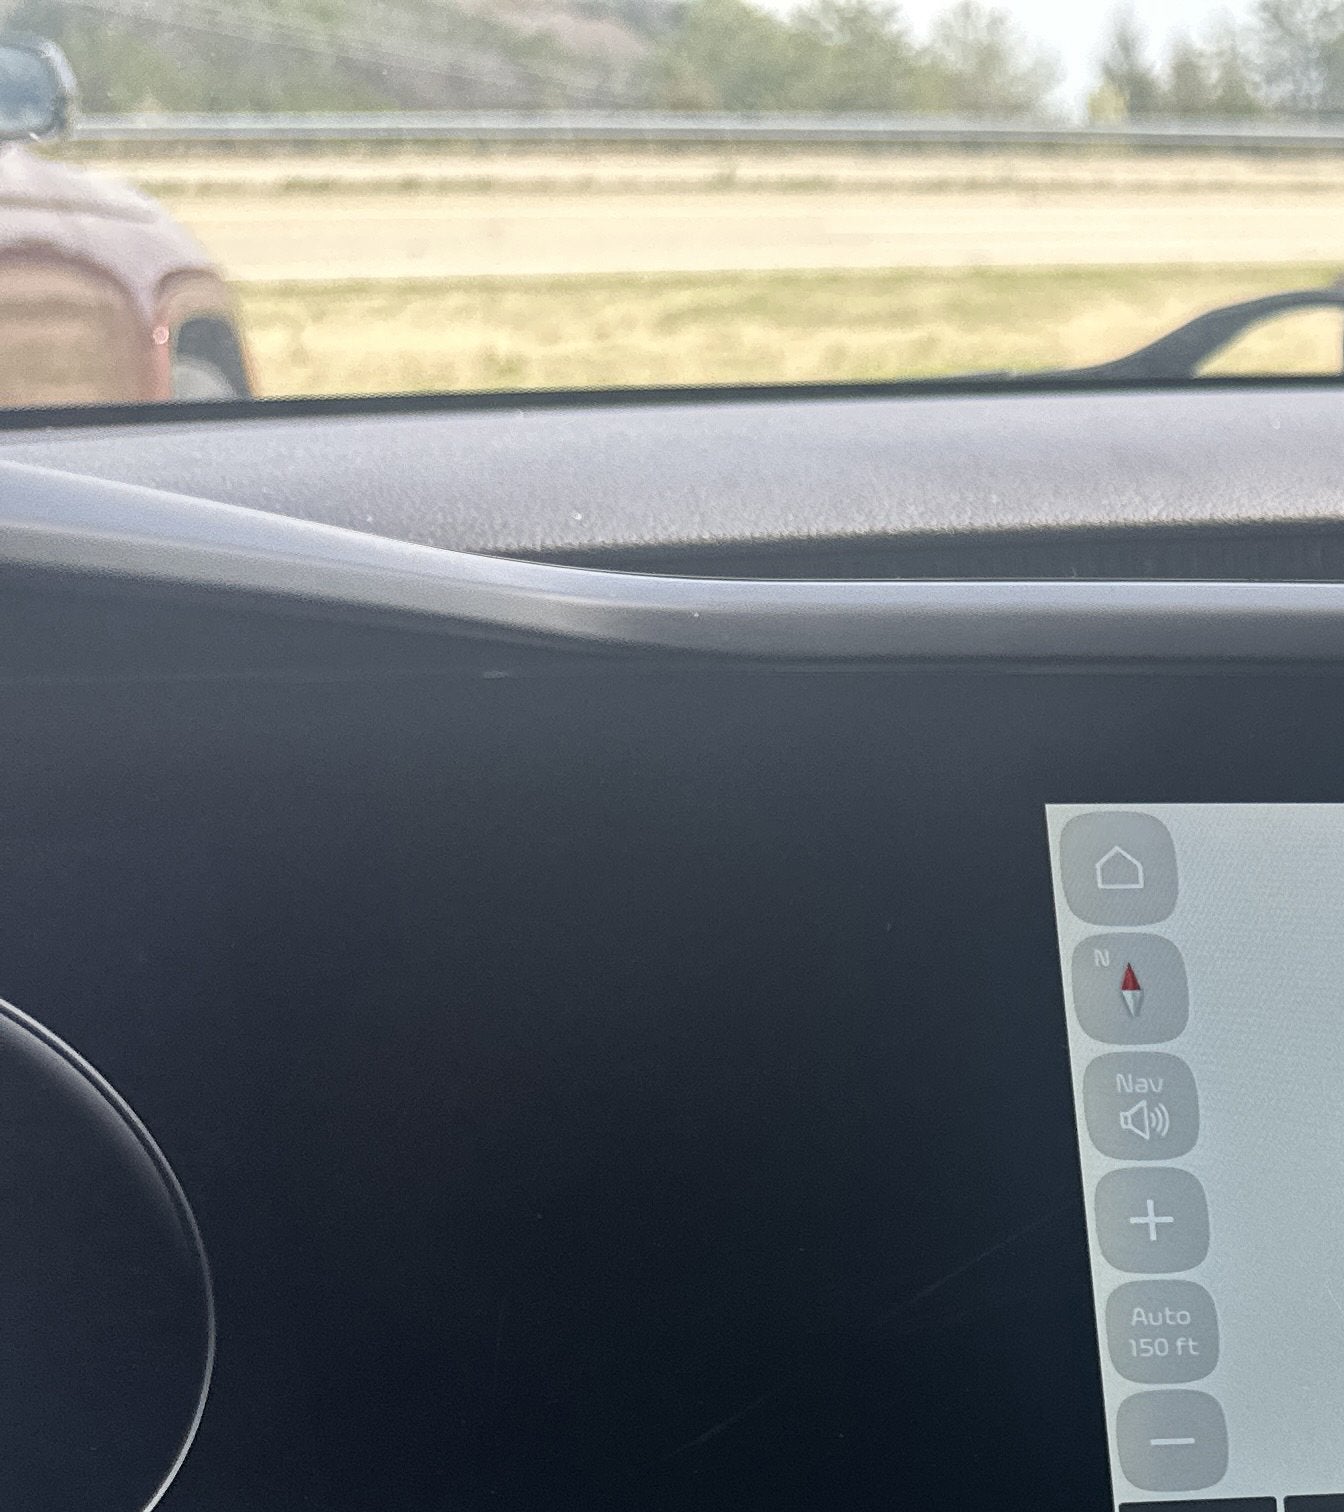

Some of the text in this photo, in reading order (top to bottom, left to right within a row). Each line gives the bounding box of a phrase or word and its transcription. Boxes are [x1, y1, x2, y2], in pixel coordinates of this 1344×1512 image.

[1094, 948, 1110, 967] N
[1115, 1073, 1163, 1093] Nav
[1130, 1307, 1191, 1327] Auto
[1128, 1337, 1200, 1357] 150 ft
